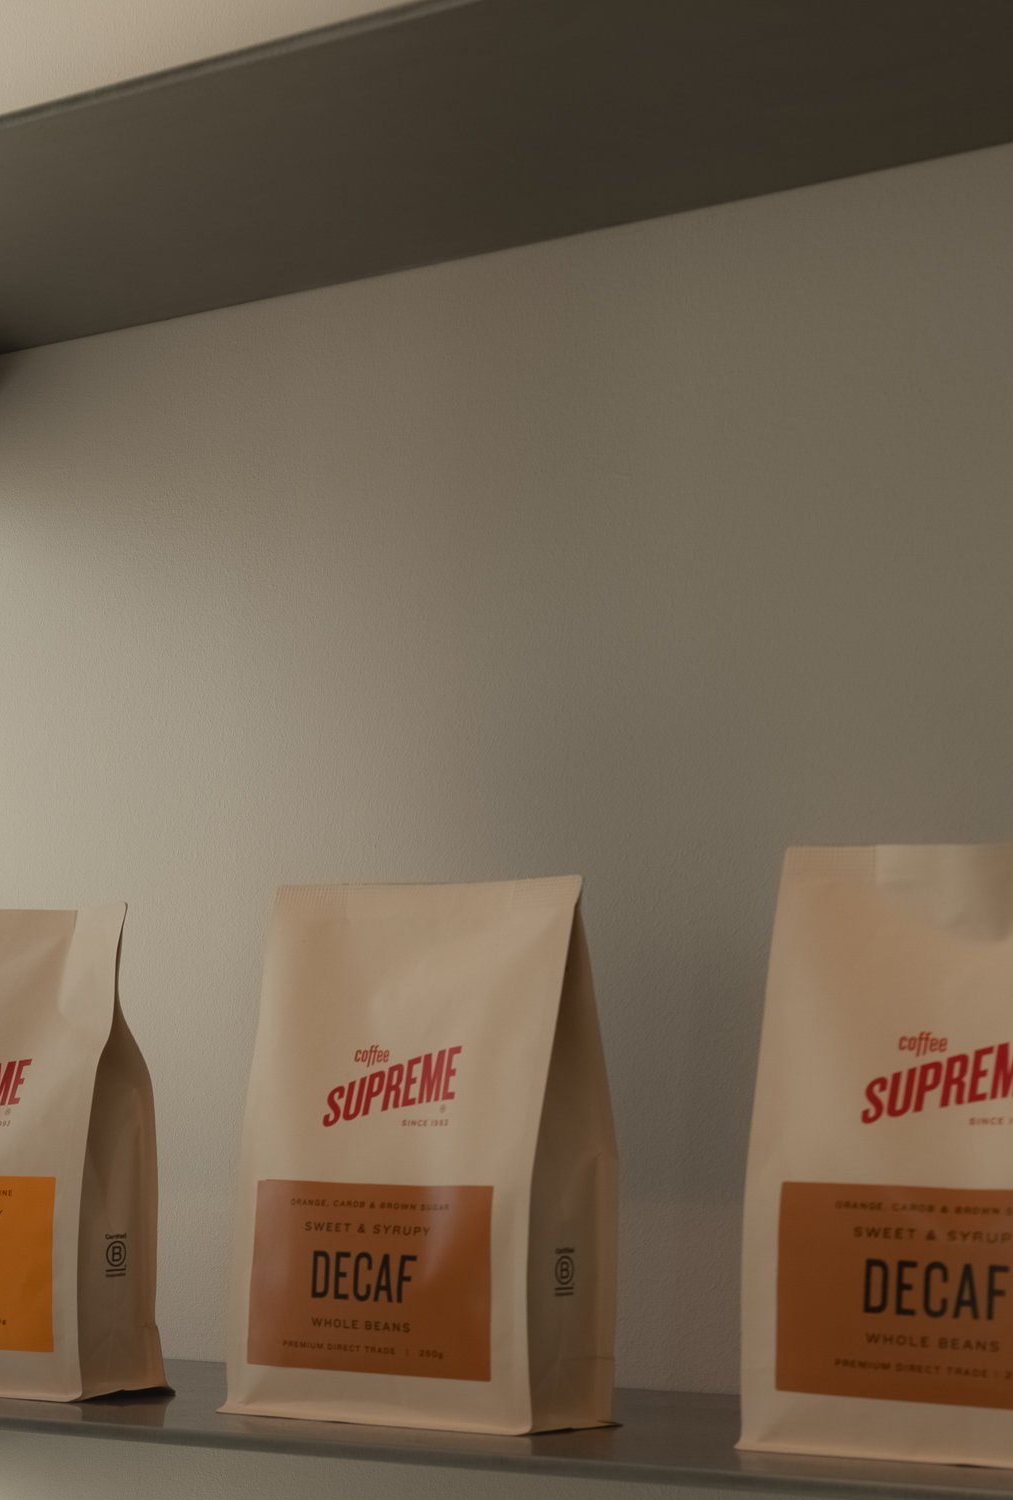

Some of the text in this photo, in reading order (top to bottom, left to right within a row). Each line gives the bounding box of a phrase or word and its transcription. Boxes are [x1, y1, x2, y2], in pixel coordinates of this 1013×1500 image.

[898, 1031, 948, 1057] coffee
[354, 1045, 390, 1067] coffee
[322, 1045, 463, 1127] SUPREME
[401, 1119, 428, 1127] SINCE
[369, 1201, 375, 1209] &
[379, 1202, 416, 1211] BROWN
[305, 1221, 431, 1236] SWEET & SYRUPY
[854, 1226, 916, 1240] SWEET
[926, 1230, 936, 1241] &
[311, 1250, 418, 1304] DECAF
[864, 1258, 1010, 1320] DECAF
[311, 1317, 411, 1333] WHOLE BEANS
[282, 1340, 324, 1350] PREMIUM
[327, 1342, 360, 1352] DIRECT
[365, 1345, 395, 1355] TRADE
[865, 1332, 1000, 1352] WHOLE BEANS
[834, 1358, 890, 1370] PREMIUM
[895, 1362, 940, 1375] DIRECT
[947, 1366, 987, 1379] TRADE
